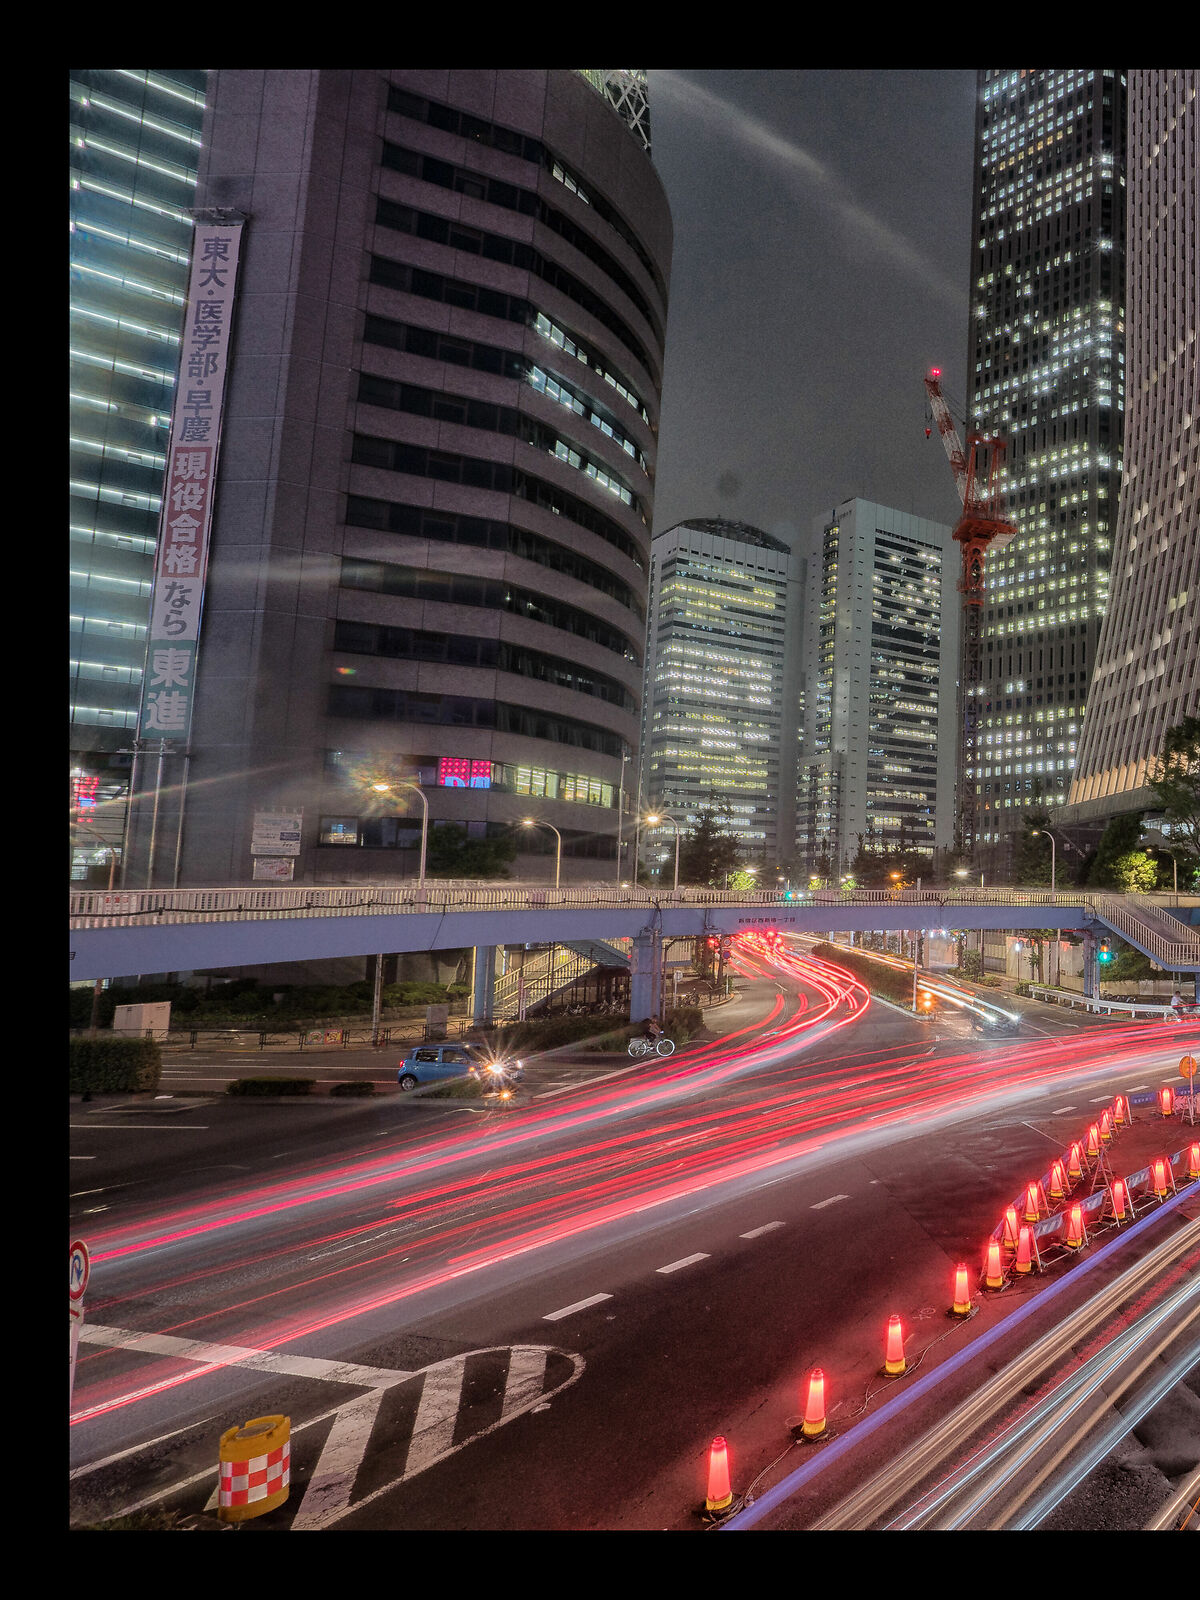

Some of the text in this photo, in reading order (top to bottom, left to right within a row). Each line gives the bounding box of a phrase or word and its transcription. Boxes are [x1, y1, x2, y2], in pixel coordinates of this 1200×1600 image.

[145, 237, 232, 731] 東大・医学部・早慶 現役合格 なら 東進
